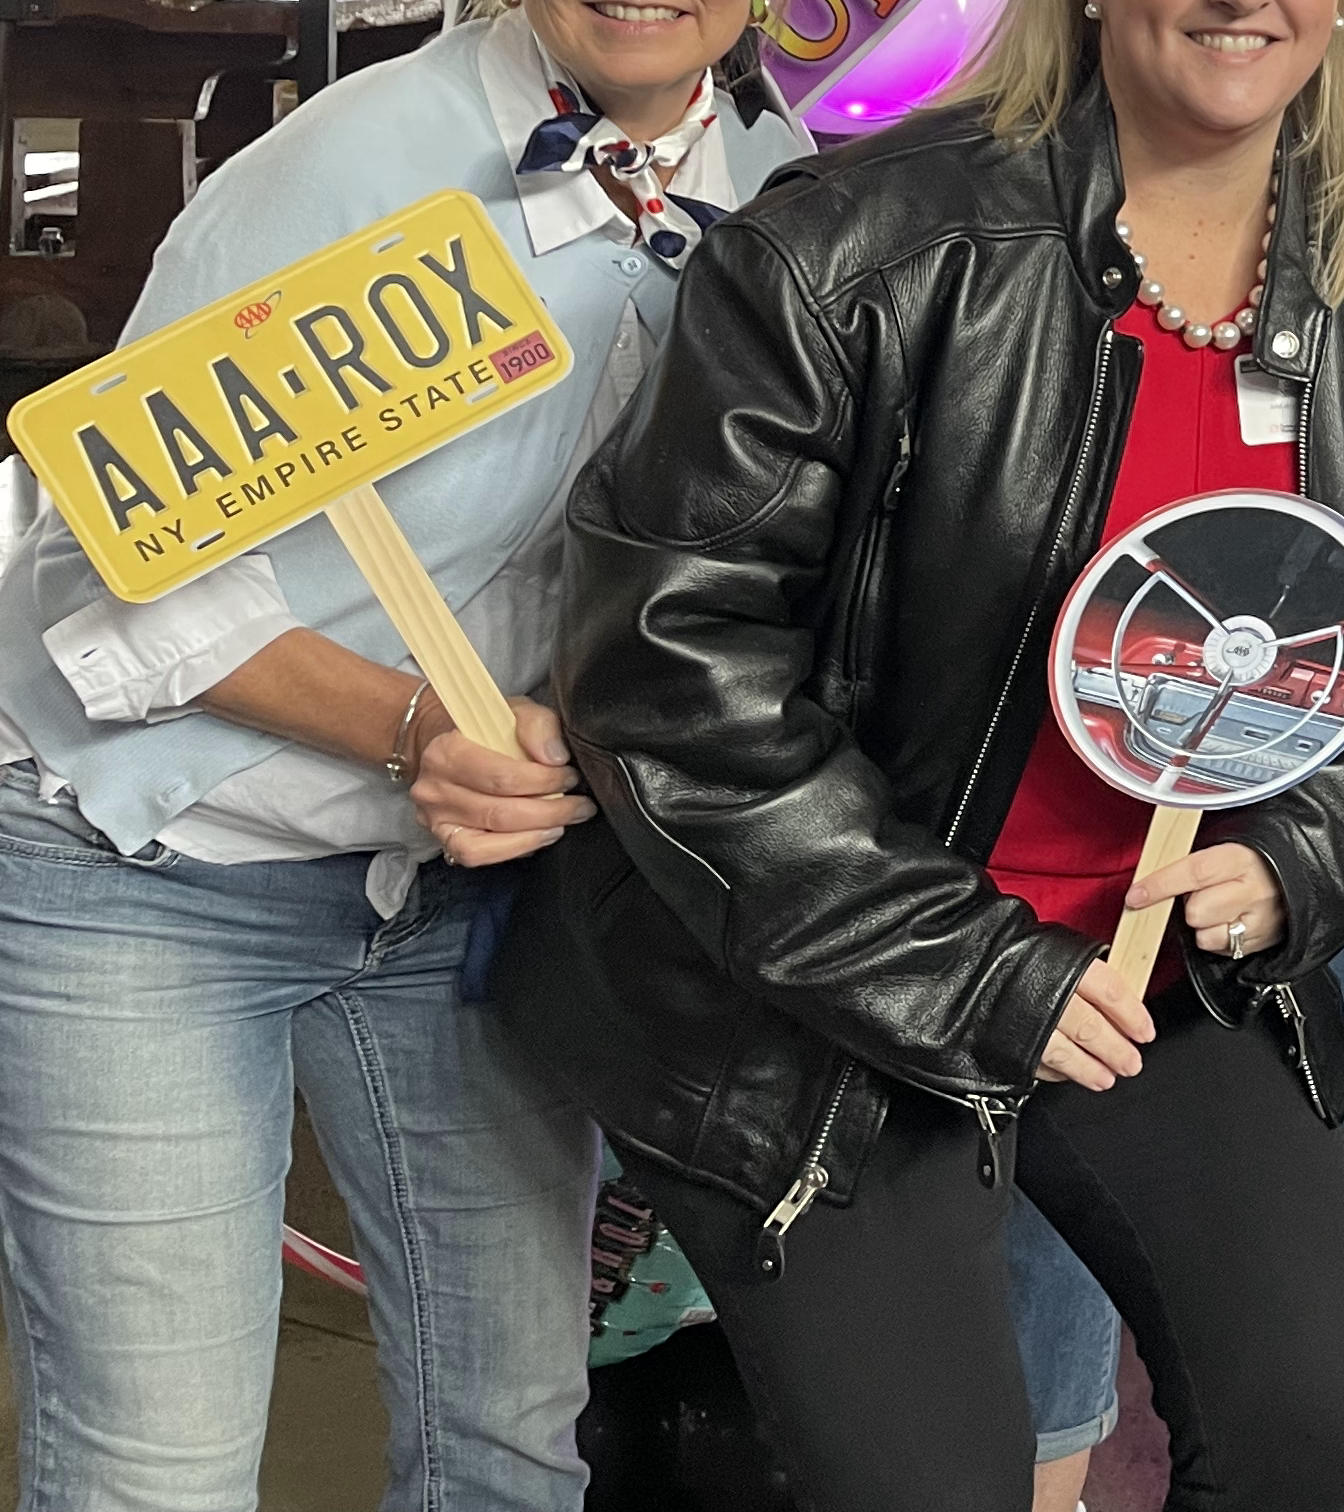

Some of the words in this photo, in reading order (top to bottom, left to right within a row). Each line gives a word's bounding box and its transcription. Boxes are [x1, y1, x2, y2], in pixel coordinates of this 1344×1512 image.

[234, 302, 272, 332] AAA
[499, 341, 552, 380] 1900
[133, 518, 187, 563] NY
[215, 425, 369, 520] EMPIRE
[378, 358, 494, 433] STATE
